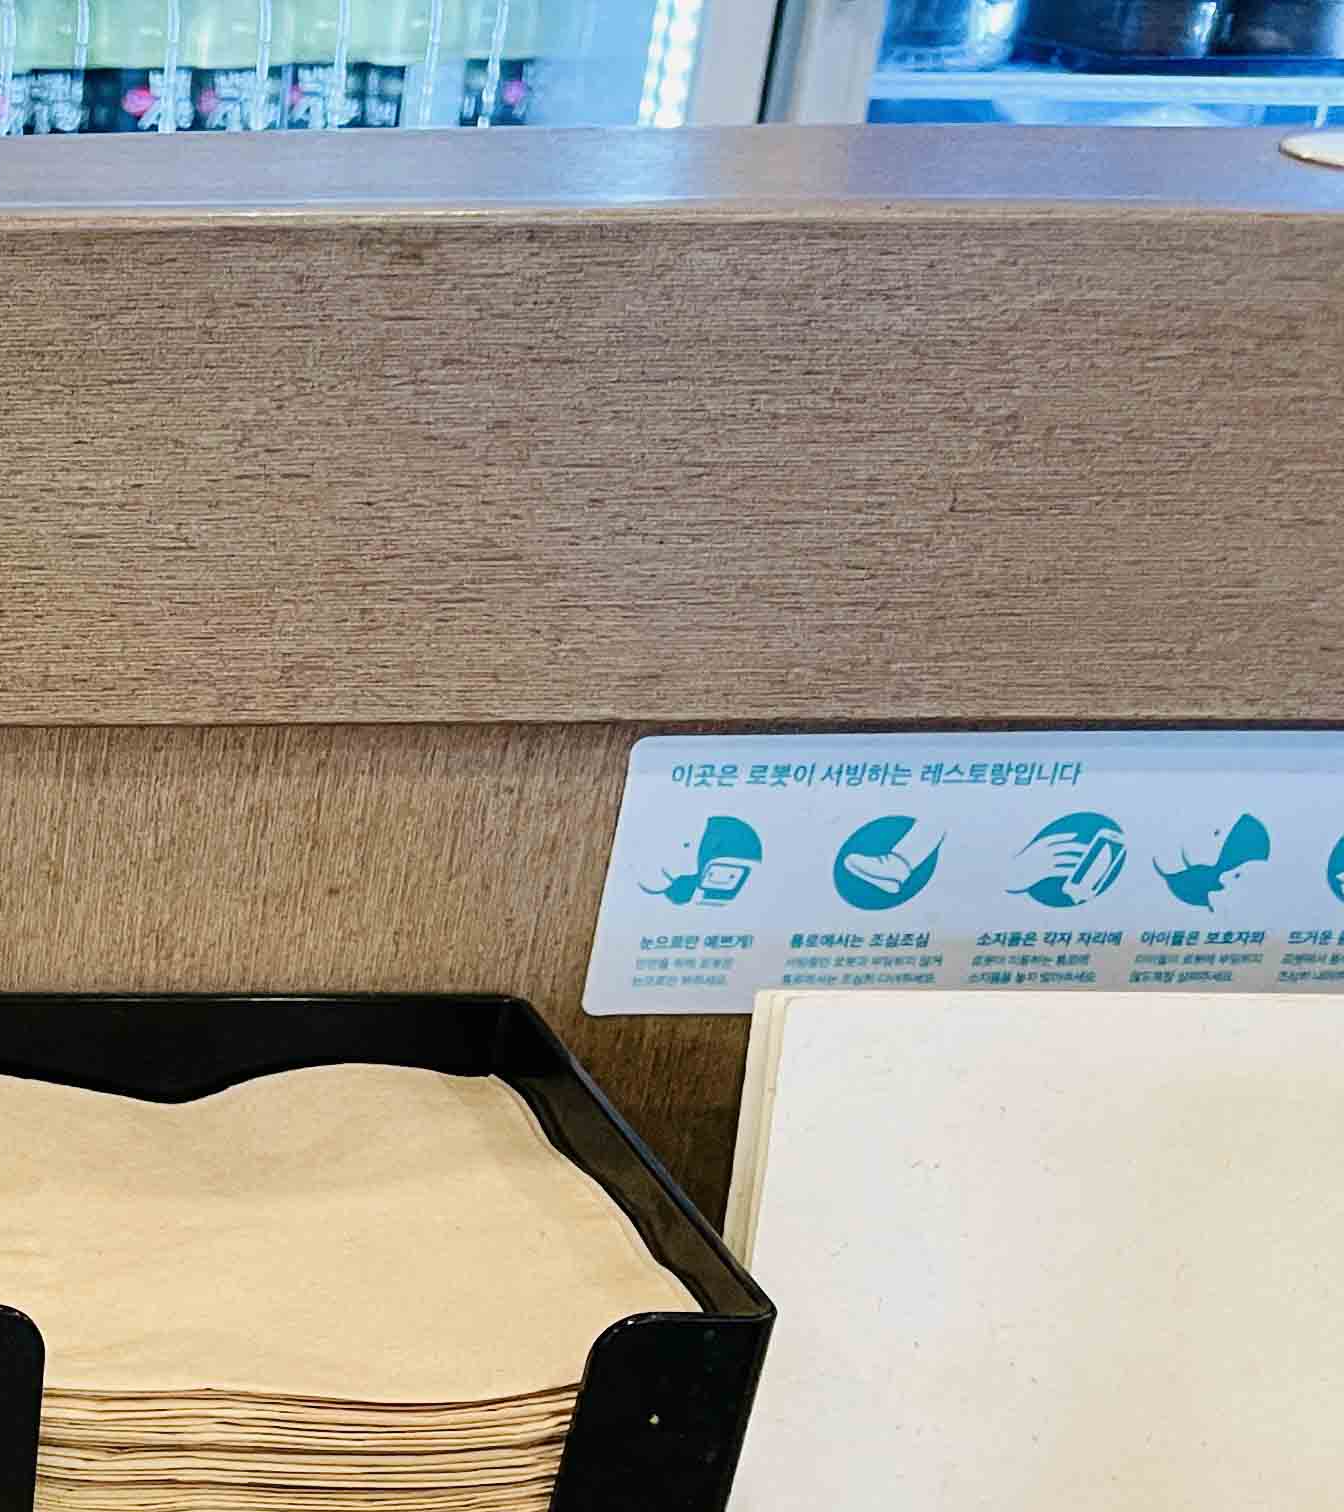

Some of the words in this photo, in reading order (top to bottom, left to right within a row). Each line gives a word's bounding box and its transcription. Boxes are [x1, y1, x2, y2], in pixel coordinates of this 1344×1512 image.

[671, 761, 740, 788] 이곳은
[745, 761, 814, 787] 로봇이
[820, 761, 913, 788] 서빙하는
[919, 760, 1084, 787] 레스토랑입니다
[869, 931, 931, 948] 조심조심
[1043, 930, 1072, 946] 각자
[1139, 930, 1200, 946] 아이들은
